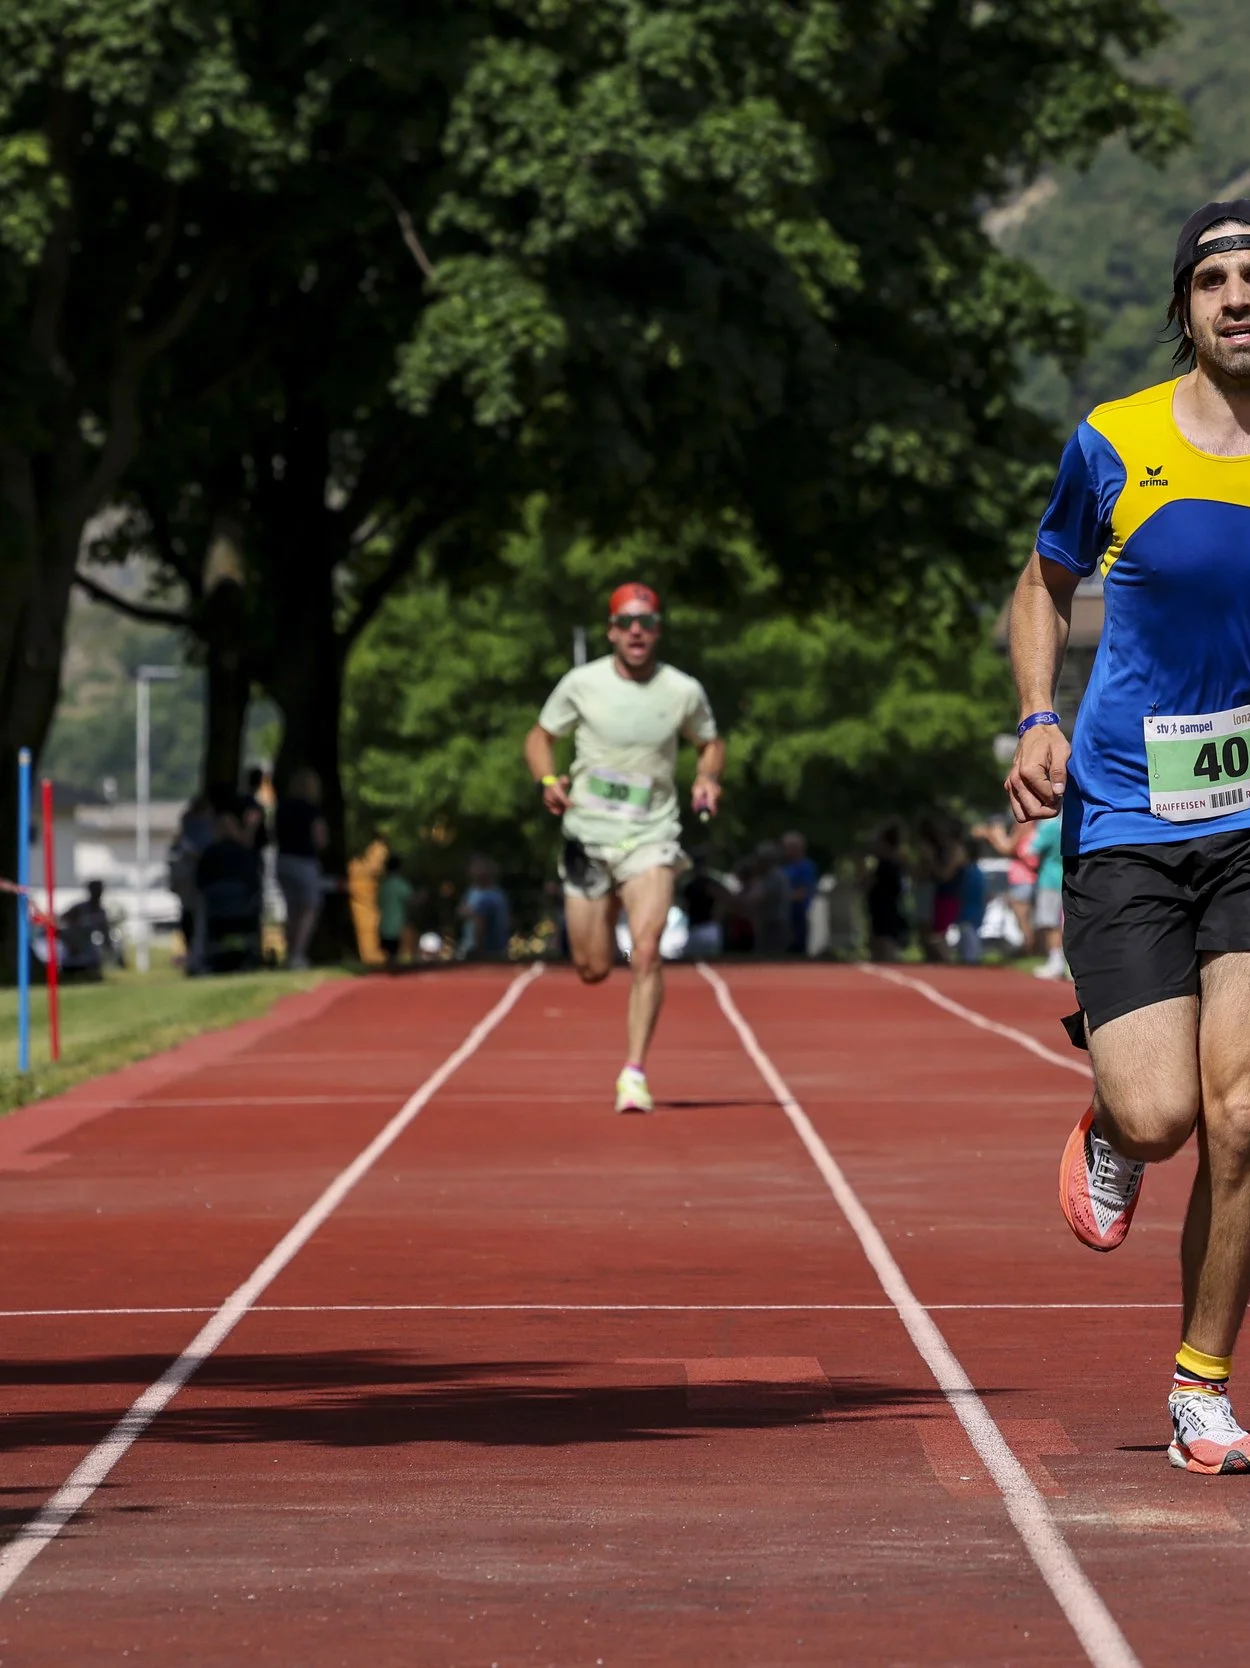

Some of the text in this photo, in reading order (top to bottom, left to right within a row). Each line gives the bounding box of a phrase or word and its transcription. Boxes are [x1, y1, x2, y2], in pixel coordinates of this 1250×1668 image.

[1139, 477, 1168, 487] erima
[1156, 720, 1213, 735] stv gampel
[1193, 736, 1249, 782] 40
[1156, 800, 1206, 812] RAIFFEISEN
